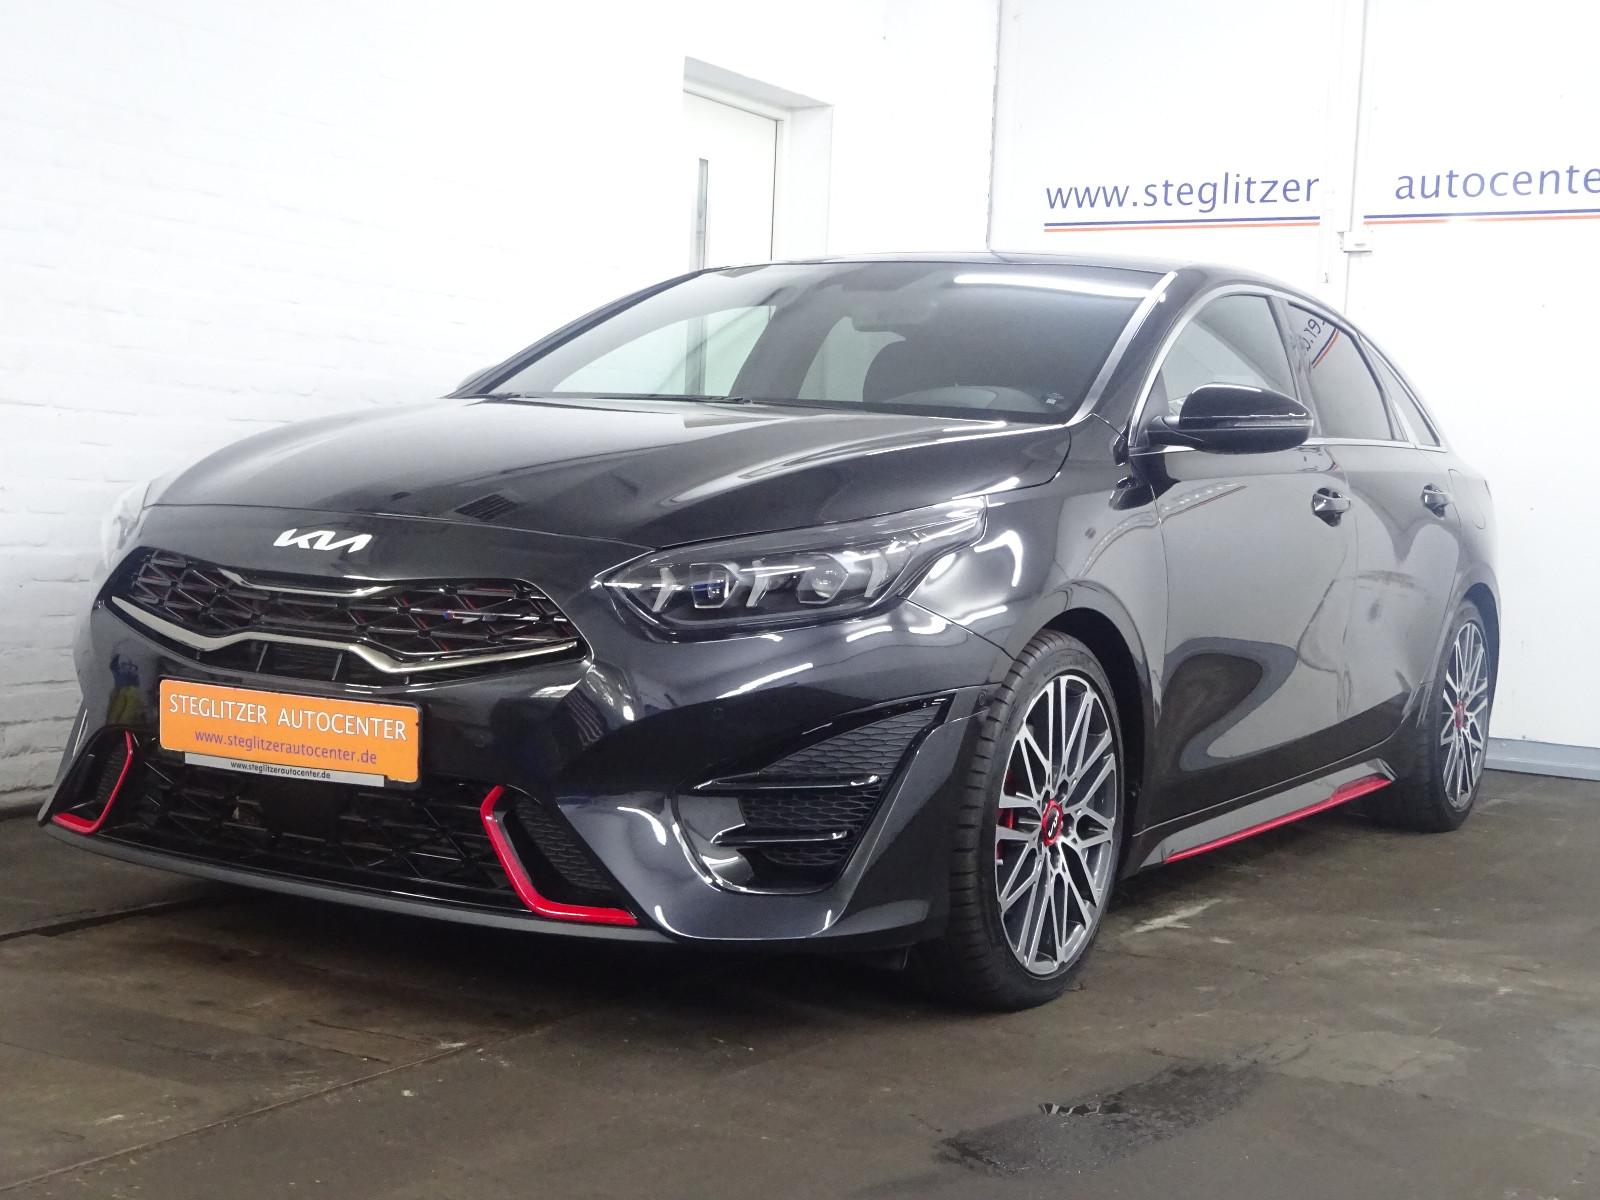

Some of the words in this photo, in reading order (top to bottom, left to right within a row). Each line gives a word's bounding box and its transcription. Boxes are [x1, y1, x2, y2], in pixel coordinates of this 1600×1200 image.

[1046, 172, 1319, 213] www.steglitzer
[1395, 165, 1600, 200] autocente
[273, 528, 373, 553] KIA
[168, 694, 268, 725] STEGLITZER
[277, 707, 407, 740] AUTOCENTER
[194, 729, 378, 764] www.steglitzerautocenter.de
[230, 760, 331, 780] www.steglitzerautocenter.de
